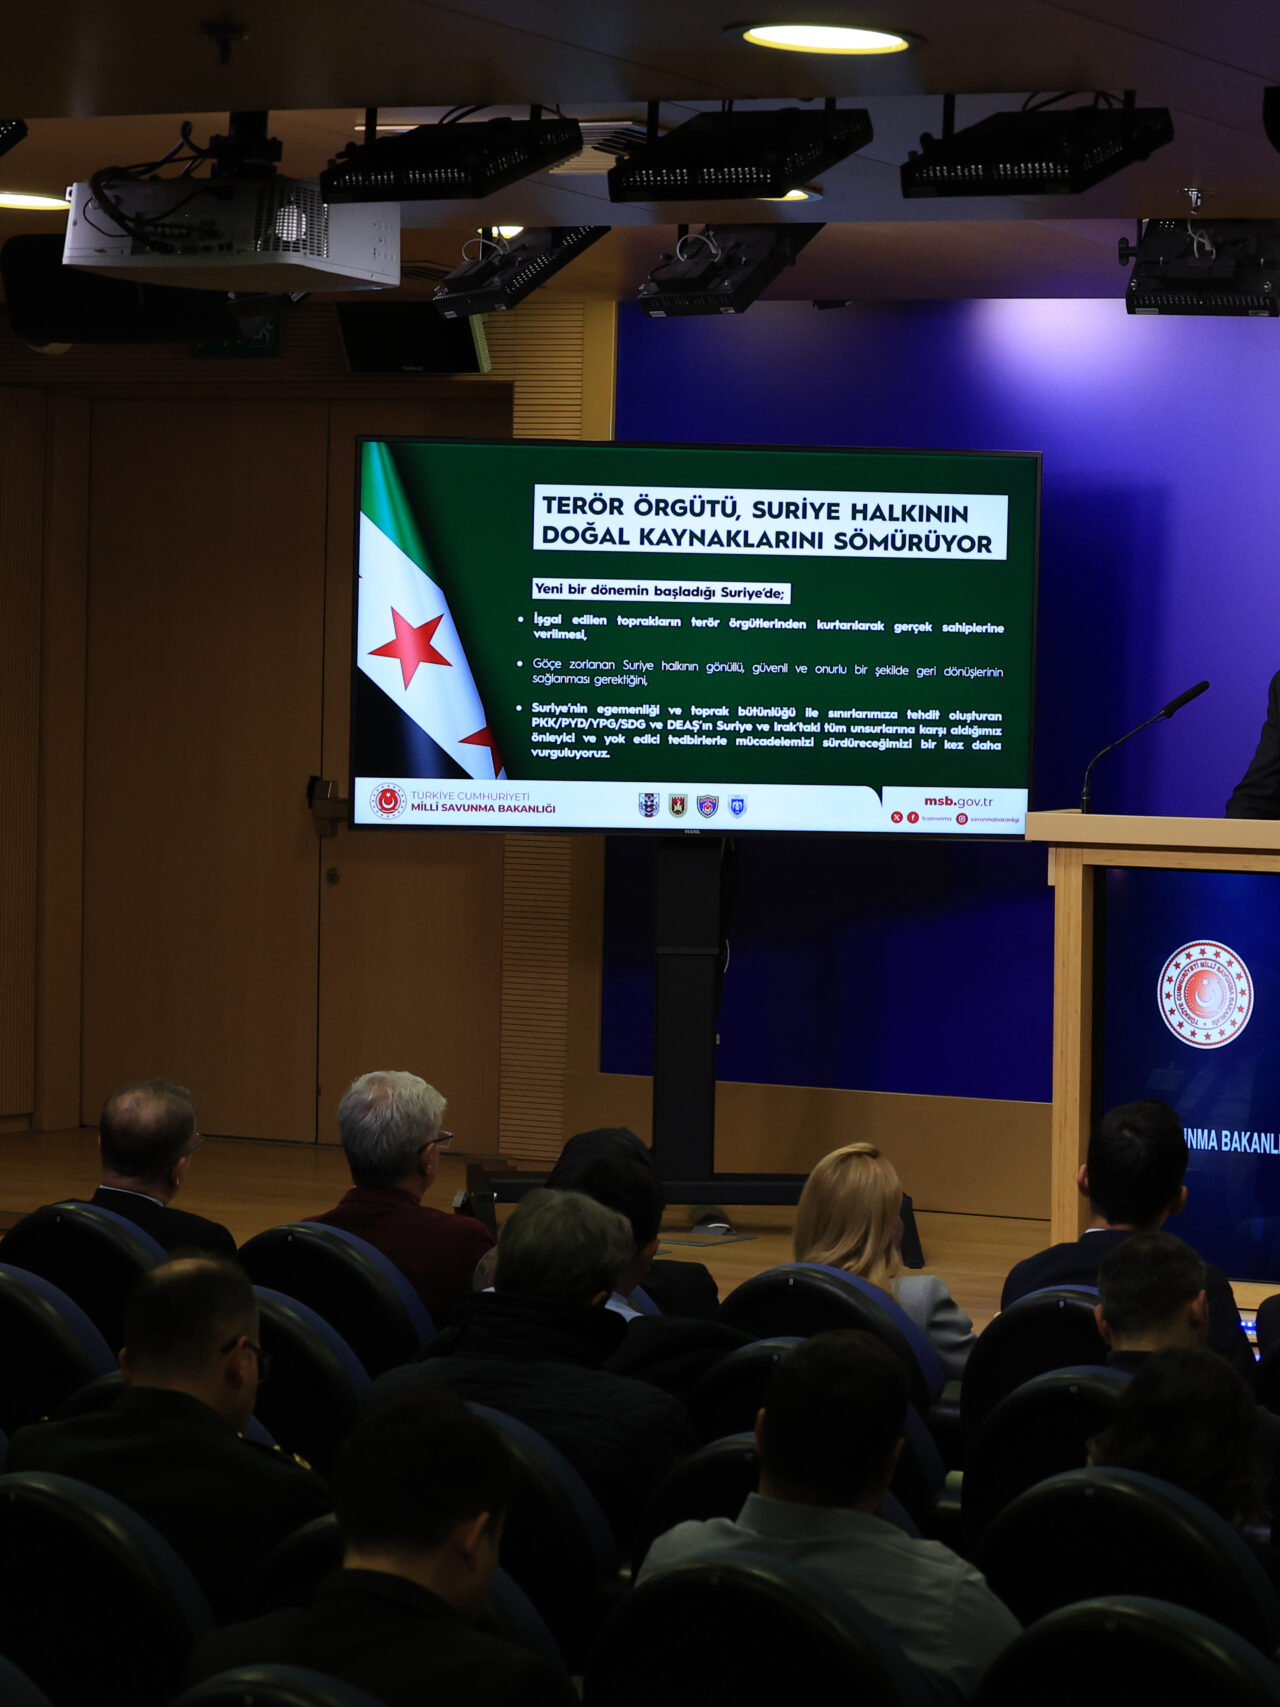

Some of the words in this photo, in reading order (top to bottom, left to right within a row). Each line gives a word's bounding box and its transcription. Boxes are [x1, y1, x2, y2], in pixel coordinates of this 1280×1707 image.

[543, 492, 624, 515] TERÖR
[634, 493, 741, 521] ÖRGÜTÜ,
[752, 497, 840, 520] SURİYE
[851, 503, 968, 523] HALKININ
[542, 522, 630, 545] DOĞAL
[640, 527, 823, 550] KAYNAKLARINI
[834, 528, 992, 553] SÖMÜRÜYOR
[535, 583, 563, 594] Yeni
[568, 584, 587, 594] bir
[591, 584, 649, 596] dönemin
[654, 586, 715, 599] başladığı
[721, 586, 785, 601] Suriye'de;
[533, 611, 562, 627] İşgal
[572, 614, 607, 626] edilen
[617, 615, 682, 628] toprakların
[691, 617, 720, 628] terör
[729, 618, 807, 631] örgütlerinden
[817, 619, 884, 631] kurtarılarak
[894, 622, 933, 634] gerçek
[942, 623, 1004, 635] sahiplerine
[533, 630, 588, 641] verilmesi,
[533, 658, 562, 671] Göçe
[569, 660, 615, 670] zorlanan
[623, 660, 654, 672] Suriye
[662, 660, 699, 672] halkının
[706, 663, 745, 674] gönüllü,
[752, 663, 788, 675] güvenli
[795, 665, 807, 674] ve
[815, 665, 847, 674] onurlu
[855, 665, 868, 675] bir
[875, 665, 909, 677] şekilde
[916, 666, 936, 678] geri
[944, 667, 1003, 679] dönüşlerinin
[532, 673, 590, 685] sağlanması
[594, 675, 648, 687] gerektiğini,
[597, 704, 660, 716] egemenliği
[668, 707, 682, 715] ve
[691, 705, 729, 718] toprak
[738, 706, 796, 720] bütünlüğü
[805, 707, 819, 718] ile
[828, 709, 898, 719] sınırlarımıza
[907, 709, 940, 720] tehdit
[949, 710, 1002, 722] oluşturan
[532, 717, 646, 730] PKK/PYD/YPG/SDG
[649, 722, 663, 730] ve
[717, 721, 753, 732] Suriye
[756, 723, 770, 731] ve
[824, 723, 846, 733] tüm
[850, 724, 915, 734] unsurlarına
[919, 725, 947, 737] karşı
[950, 726, 1002, 737] aldığımız
[531, 733, 575, 745] önleyici
[583, 735, 597, 744] ve
[604, 734, 625, 745] yok
[633, 734, 660, 744] edici
[668, 735, 727, 746] tedbirlerle
[736, 736, 814, 747] mücadelemizi
[822, 738, 912, 751] sürdüreceğimizi
[921, 739, 936, 749] bir
[944, 740, 964, 750] kez
[972, 741, 1001, 750] daha
[531, 748, 610, 760] vurguluyoruz.
[411, 789, 454, 800] TÜRKİYE
[458, 791, 530, 801] CUMHURİYETİ
[925, 796, 994, 808] msb.gov.tr
[441, 803, 495, 812] SAVUNMA
[498, 803, 556, 813] BAKANLIĞI
